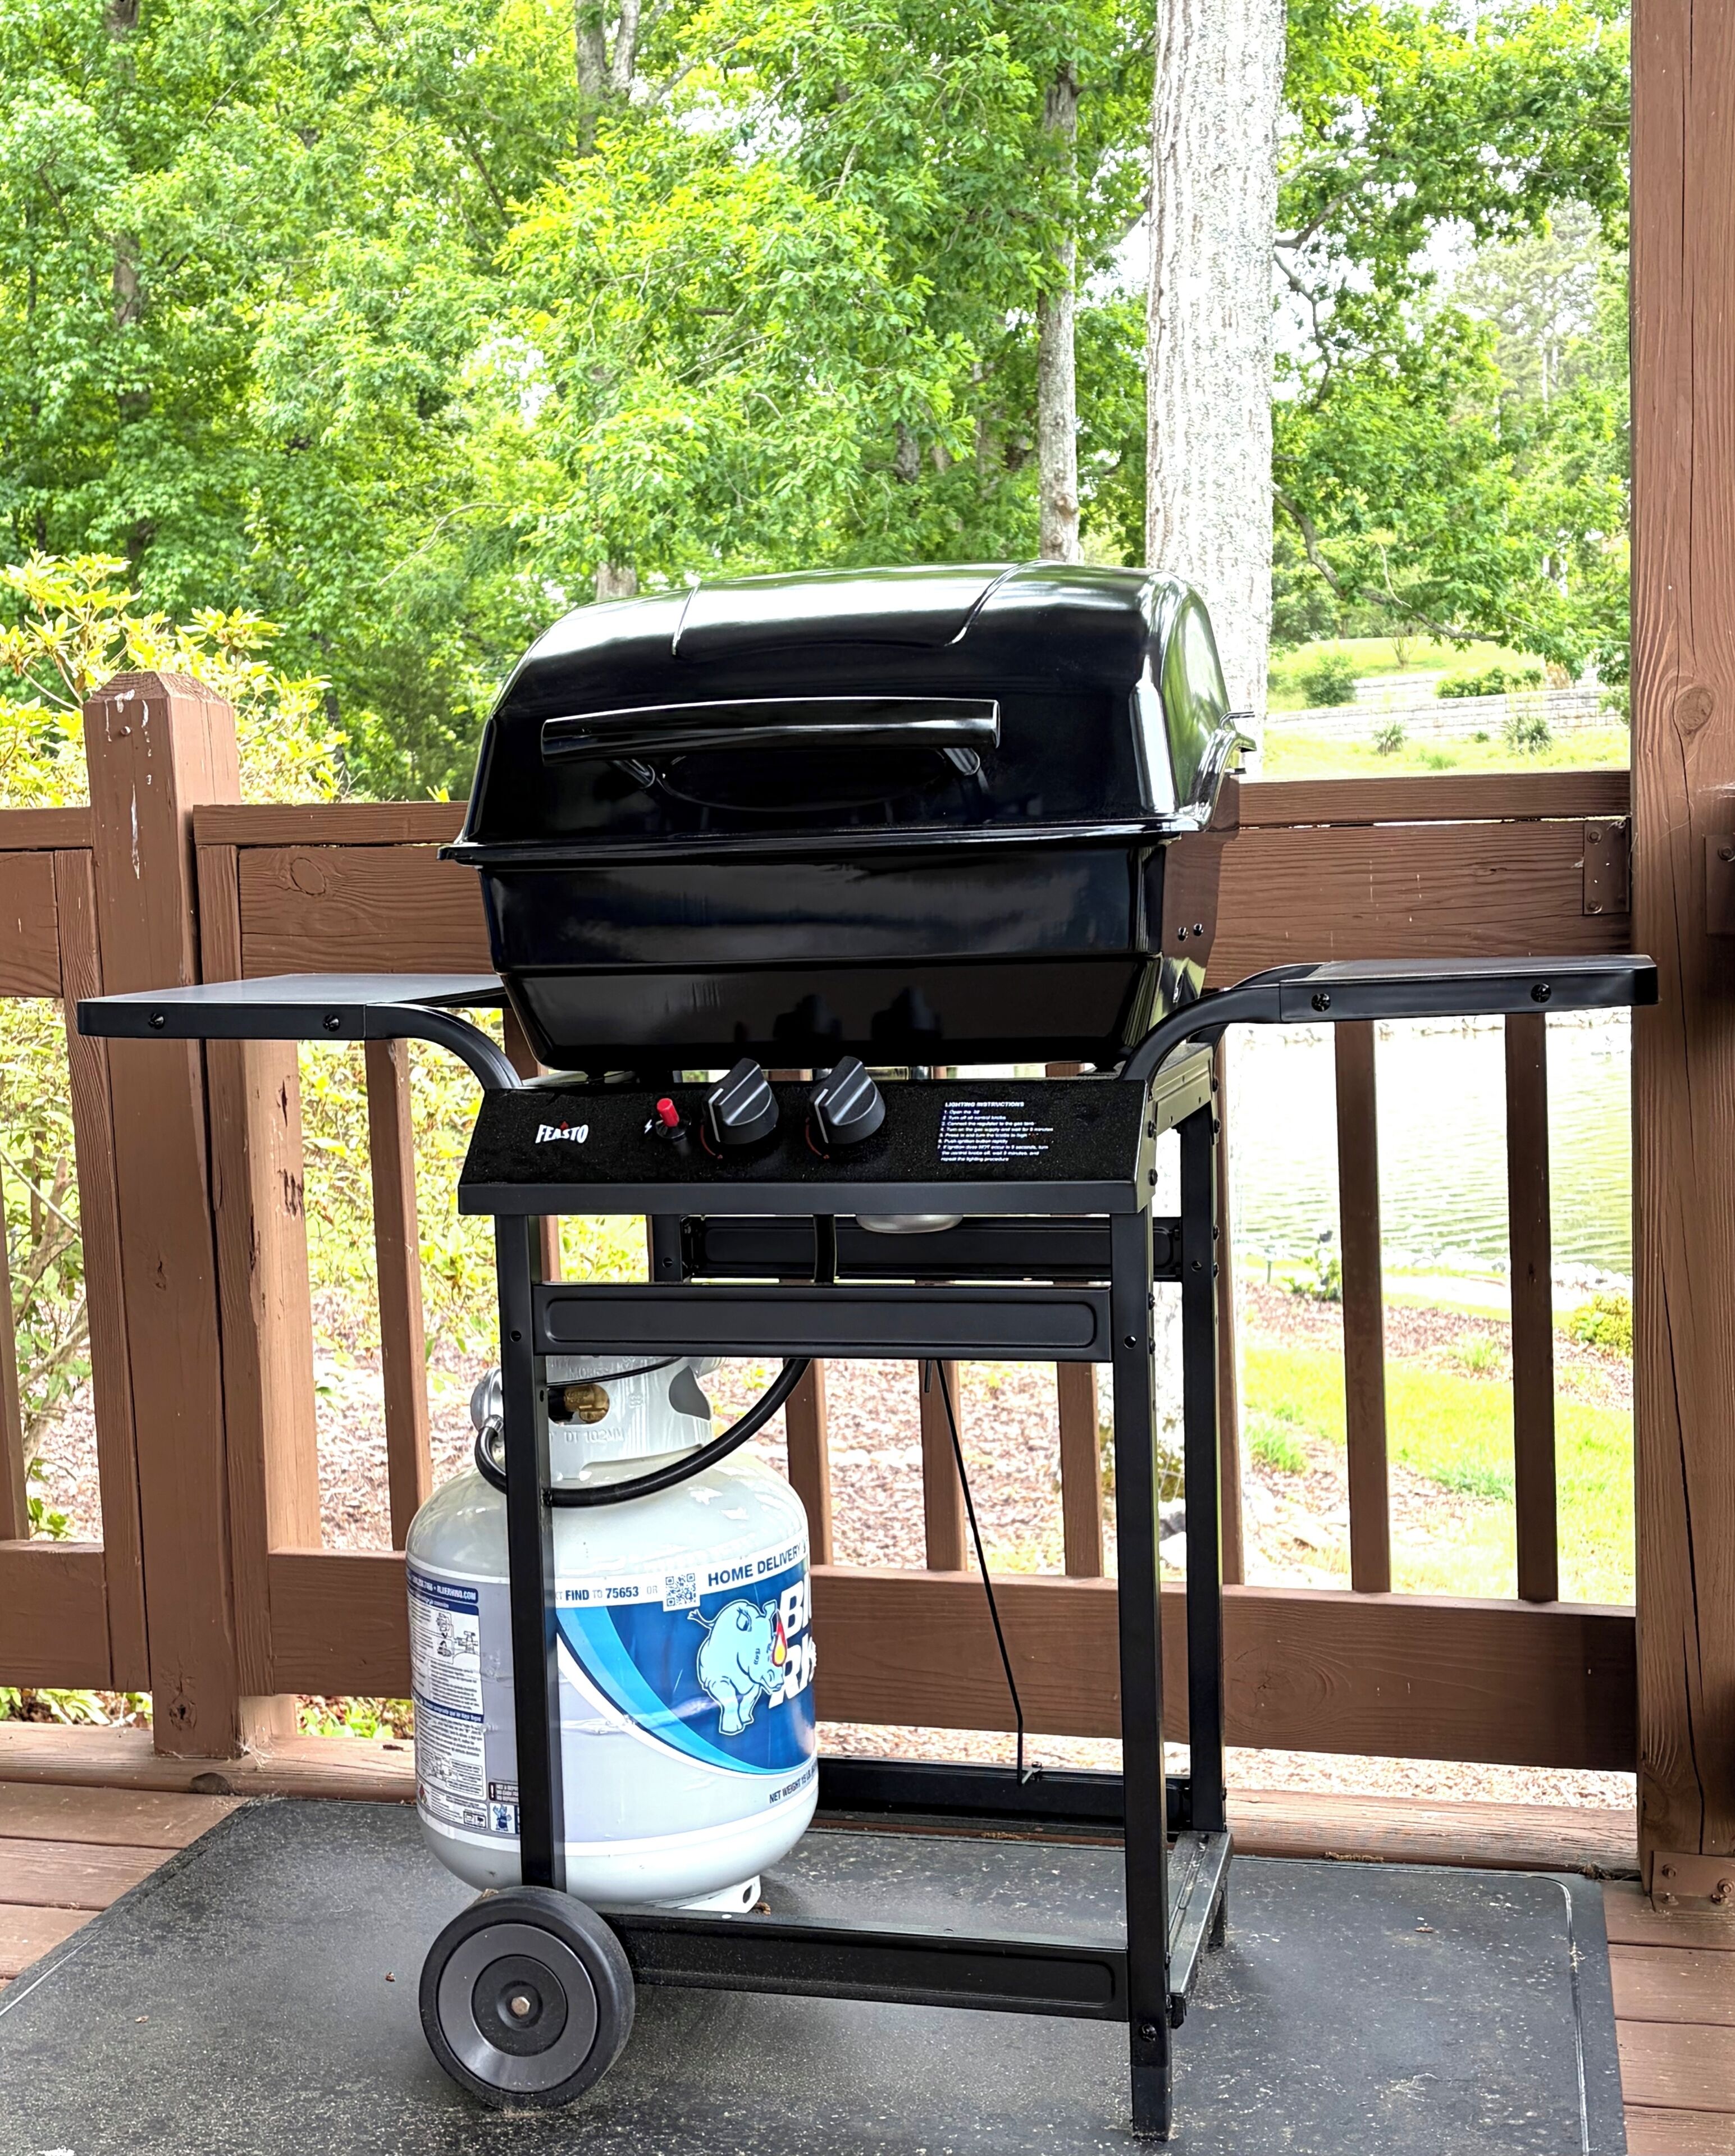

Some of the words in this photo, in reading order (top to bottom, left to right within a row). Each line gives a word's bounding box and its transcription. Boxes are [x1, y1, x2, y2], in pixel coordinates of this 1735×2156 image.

[535, 1124, 588, 1144] FEASTO
[708, 1564, 754, 1587] HOME
[757, 1543, 801, 1574] DELIVERY
[565, 1589, 590, 1601] FIND
[592, 1590, 602, 1598] TO
[605, 1586, 639, 1599] 75653
[646, 1586, 658, 1595] OR
[769, 1790, 781, 1804] NET
